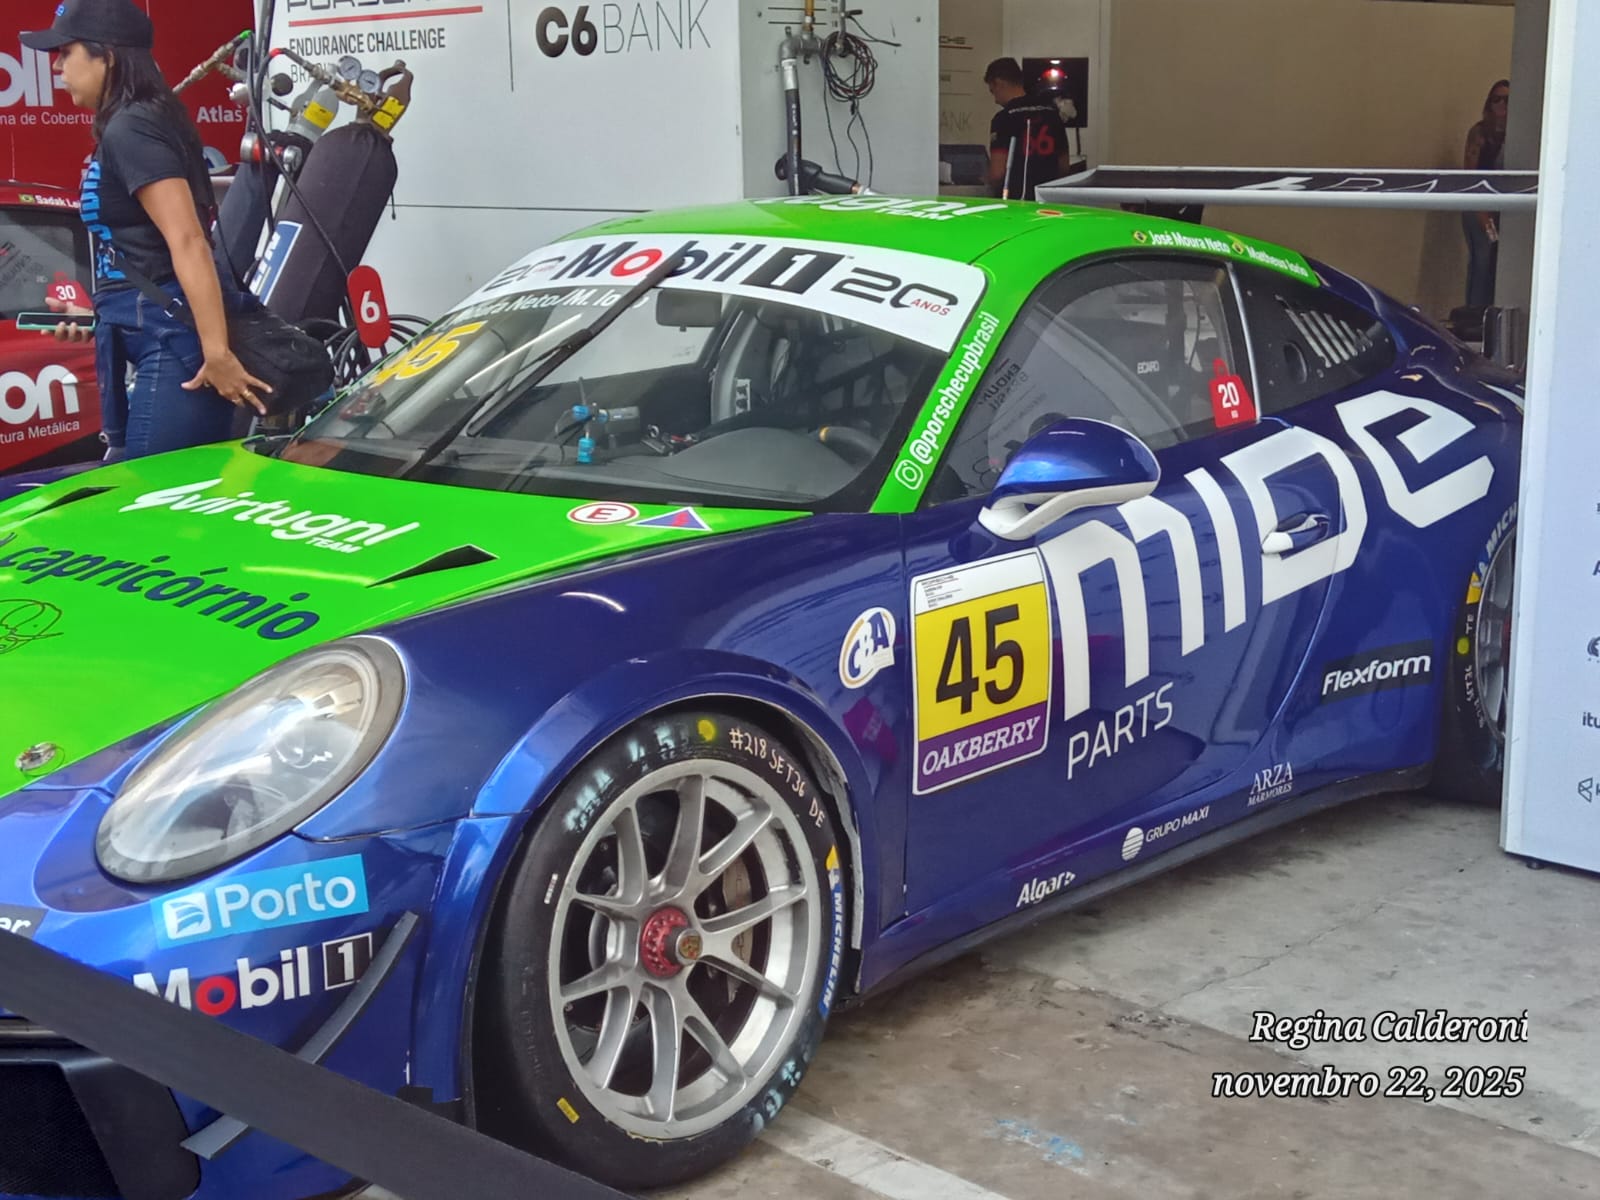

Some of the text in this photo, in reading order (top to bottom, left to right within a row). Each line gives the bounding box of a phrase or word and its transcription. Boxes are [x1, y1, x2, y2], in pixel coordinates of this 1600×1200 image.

[289, 28, 446, 57] ENDURANCE CHALLENGE
[20, 112, 36, 125] de
[196, 105, 243, 123] Atlas
[550, 240, 767, 283] Mobil
[55, 285, 76, 300] 30
[360, 290, 381, 324] 6
[911, 298, 950, 317] ANOS
[909, 310, 1000, 465] @porschecupbrasil
[1218, 382, 1240, 408] 20
[28, 420, 80, 440] Metálica
[305, 536, 362, 553] TEAM
[936, 603, 1025, 715] 45
[1322, 653, 1432, 697] Flexform
[921, 715, 1041, 776] OAKBERRY
[1067, 681, 1174, 780] PARTS
[728, 728, 767, 759] #218
[809, 797, 825, 828] DE
[1250, 761, 1293, 795] ARZA
[1146, 805, 1210, 842] GRUPO MAXI
[214, 872, 357, 929] Porto
[823, 891, 844, 1009] MICHELIN
[133, 946, 311, 1016] Mobil
